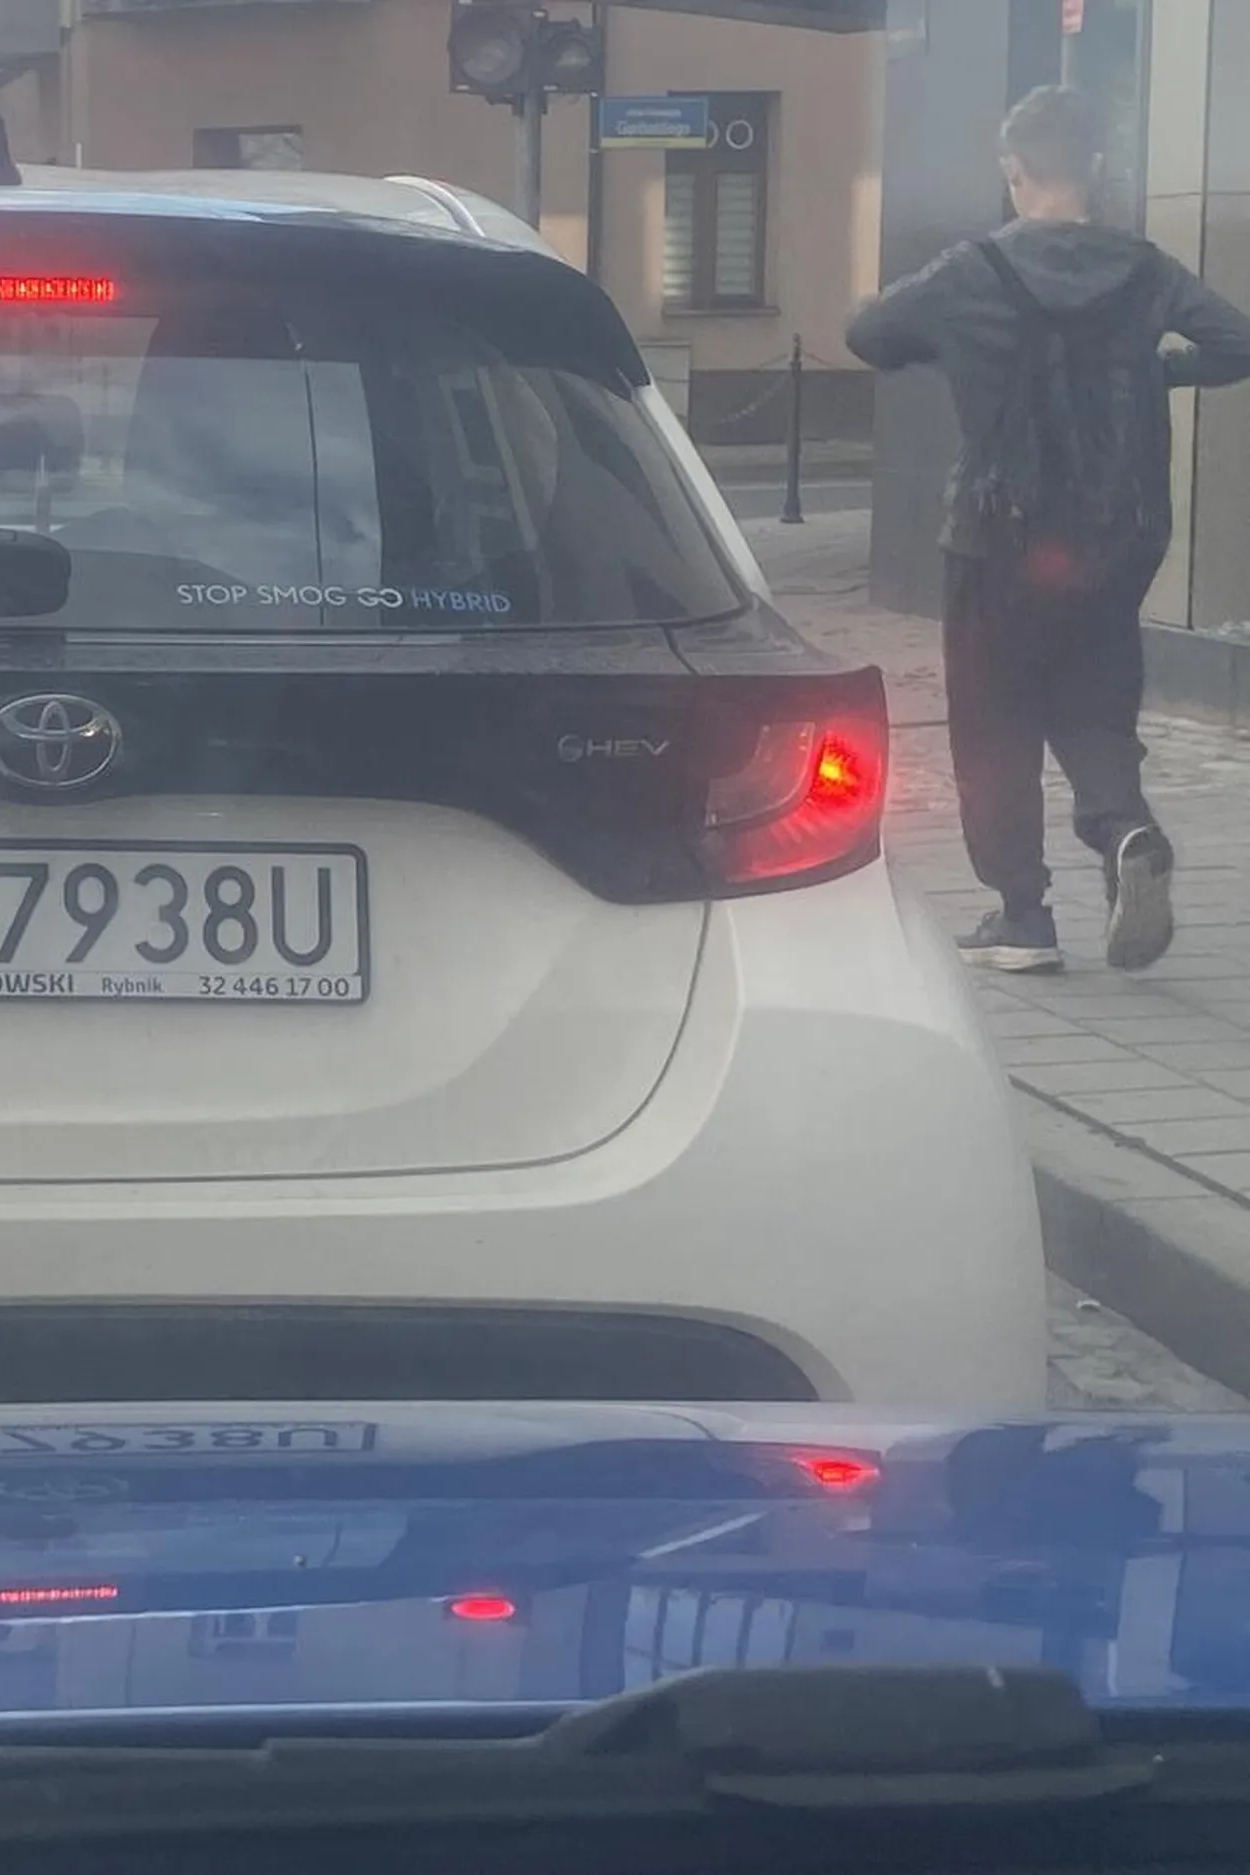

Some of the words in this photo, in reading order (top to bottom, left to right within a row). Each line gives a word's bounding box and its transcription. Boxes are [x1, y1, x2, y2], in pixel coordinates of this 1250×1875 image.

[177, 584, 247, 605] STOP
[257, 585, 347, 606] SMOG
[357, 587, 403, 608] GO
[411, 587, 512, 613] HYBRID
[101, 977, 164, 996] Rybnik
[199, 976, 225, 995] 32
[233, 976, 278, 996] 446
